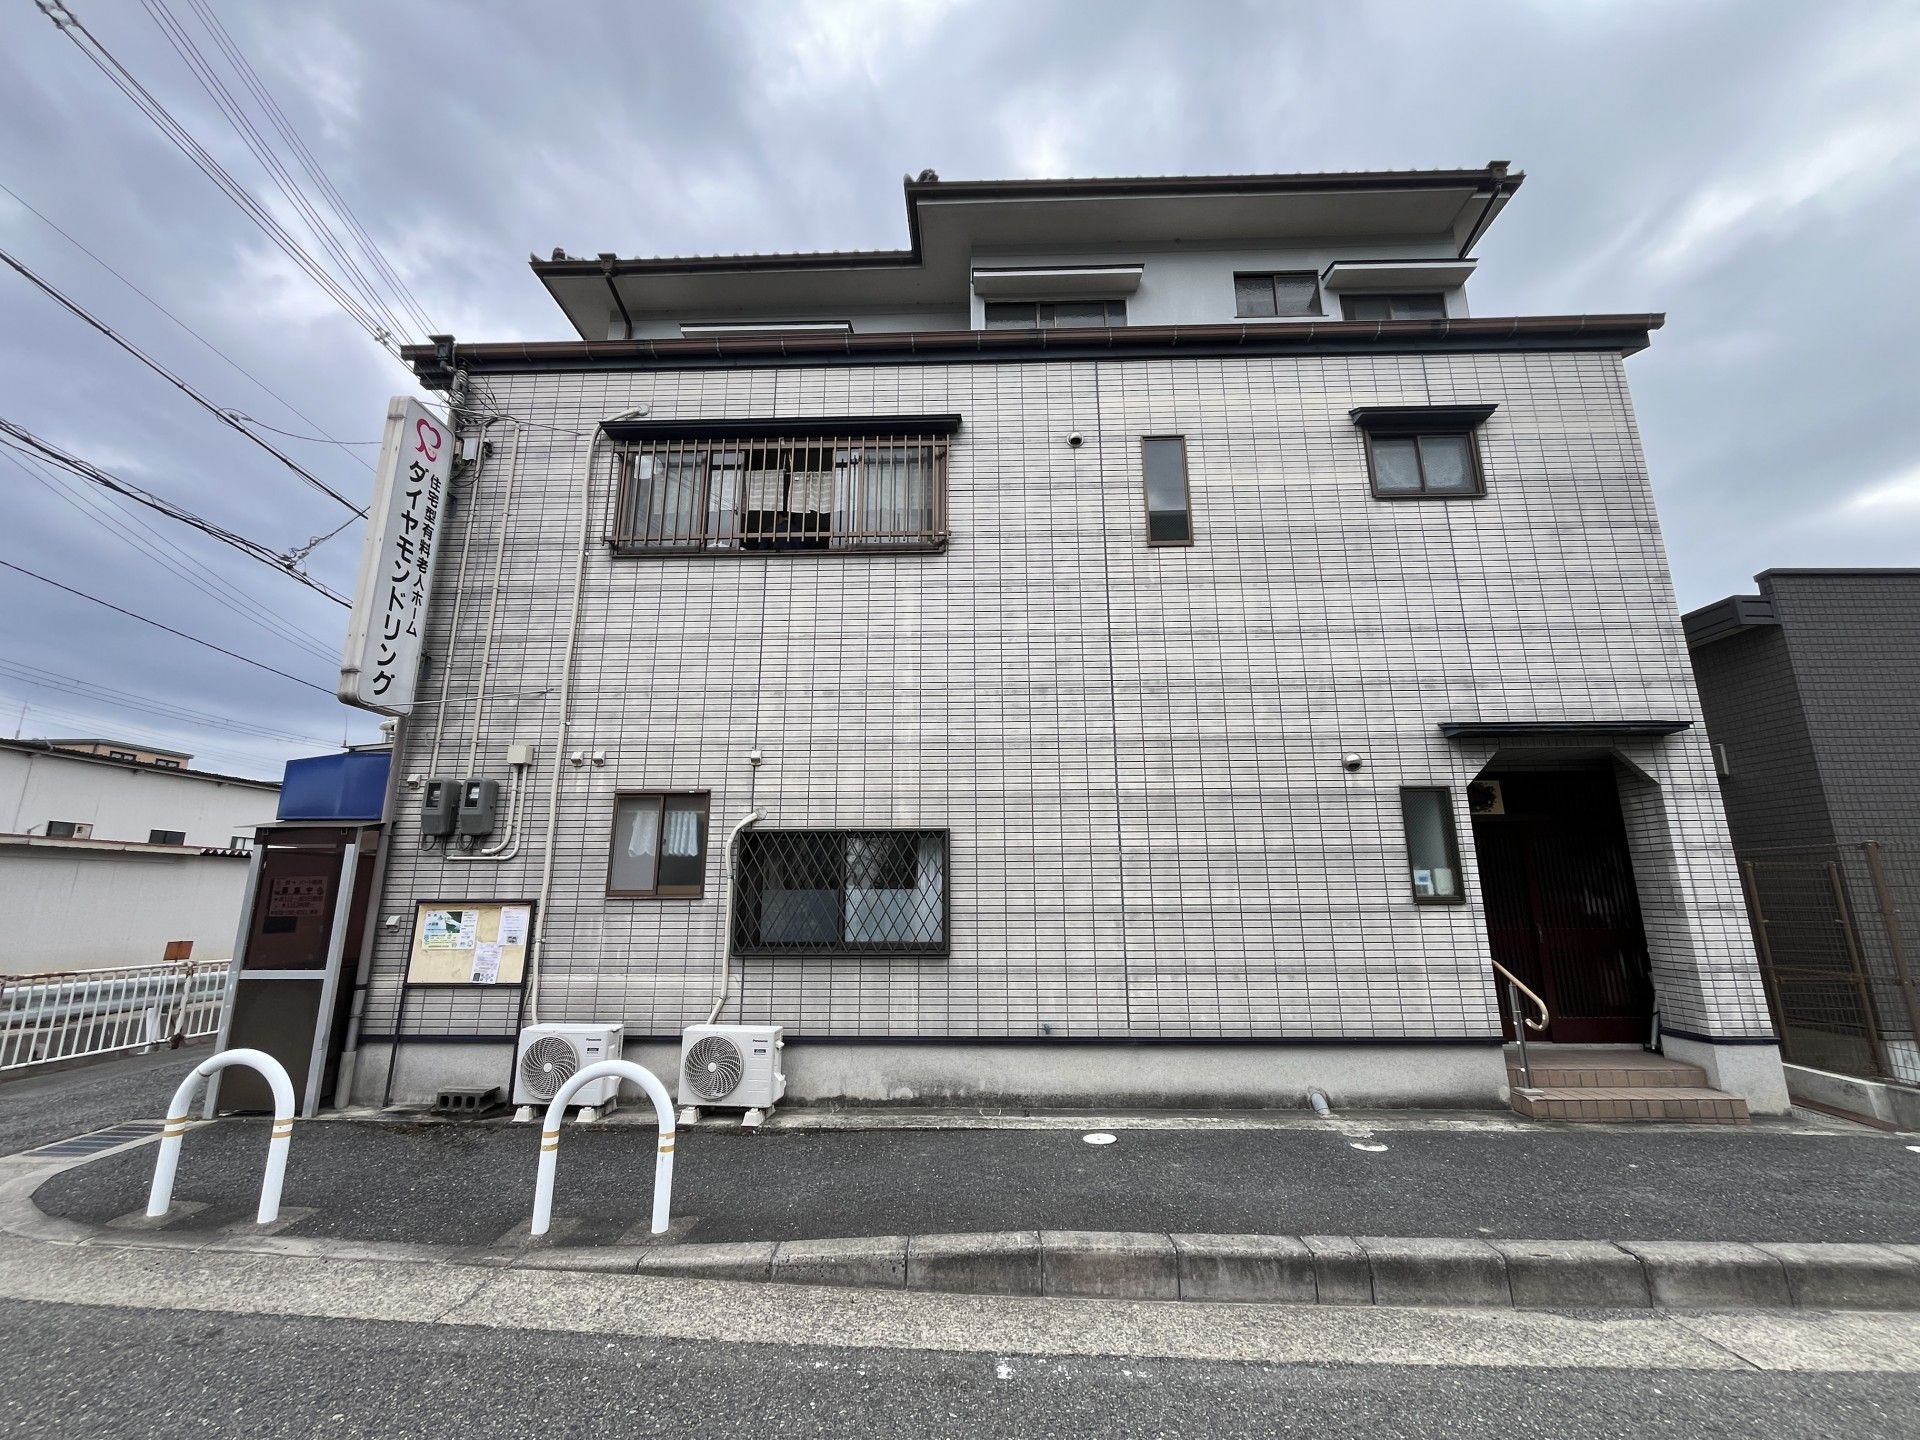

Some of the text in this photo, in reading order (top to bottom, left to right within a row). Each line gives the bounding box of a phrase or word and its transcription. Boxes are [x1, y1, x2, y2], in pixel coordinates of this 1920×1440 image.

[373, 461, 429, 695] ダイヤモンドリング
[406, 474, 441, 637] 住宅型有料老人ホーム
